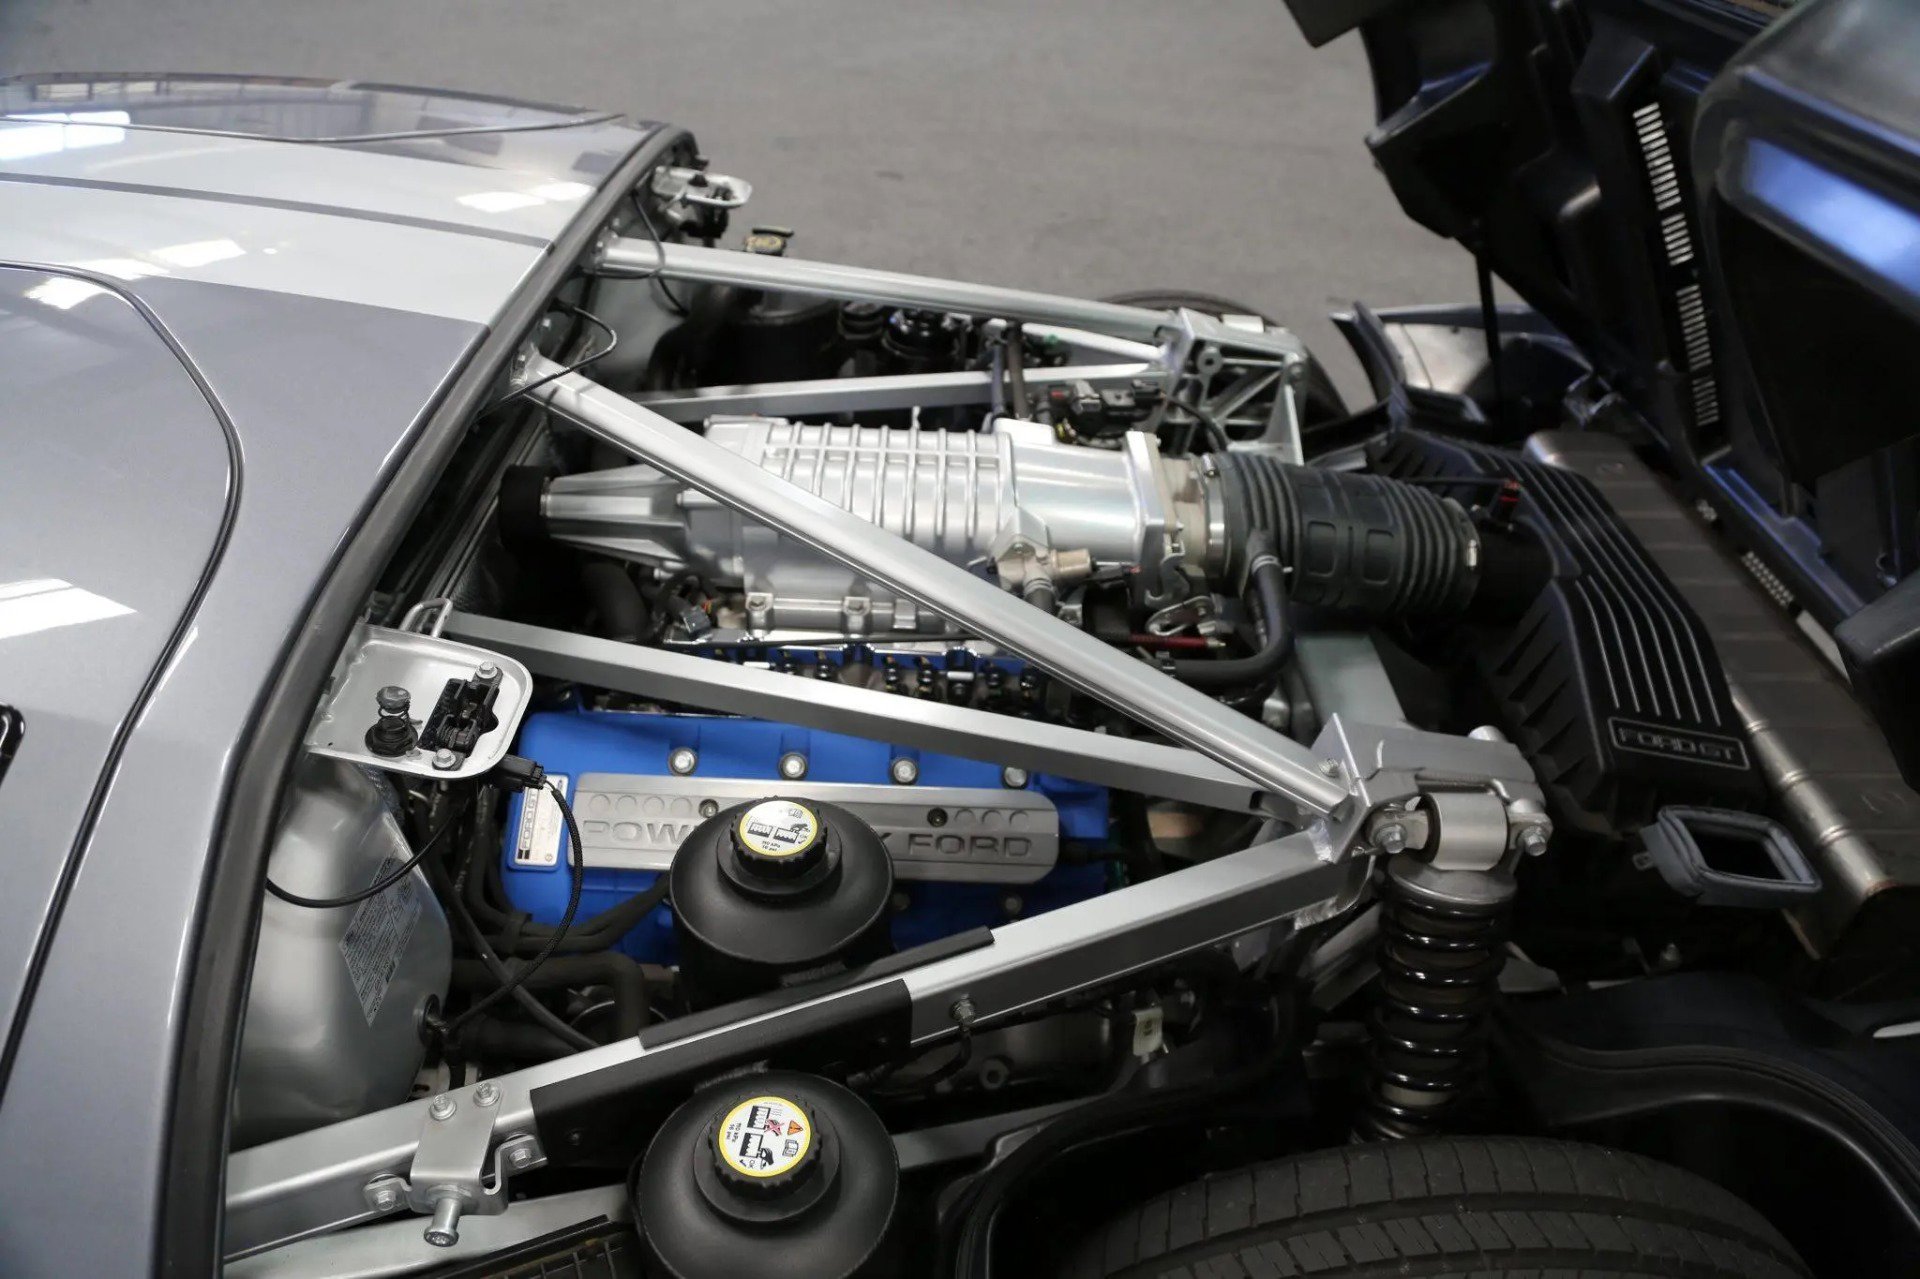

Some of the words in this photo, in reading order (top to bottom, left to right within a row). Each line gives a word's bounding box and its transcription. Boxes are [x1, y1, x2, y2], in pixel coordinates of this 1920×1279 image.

[521, 811, 534, 849] FORD
[583, 820, 699, 845] POW
[908, 833, 1032, 857] FORD
